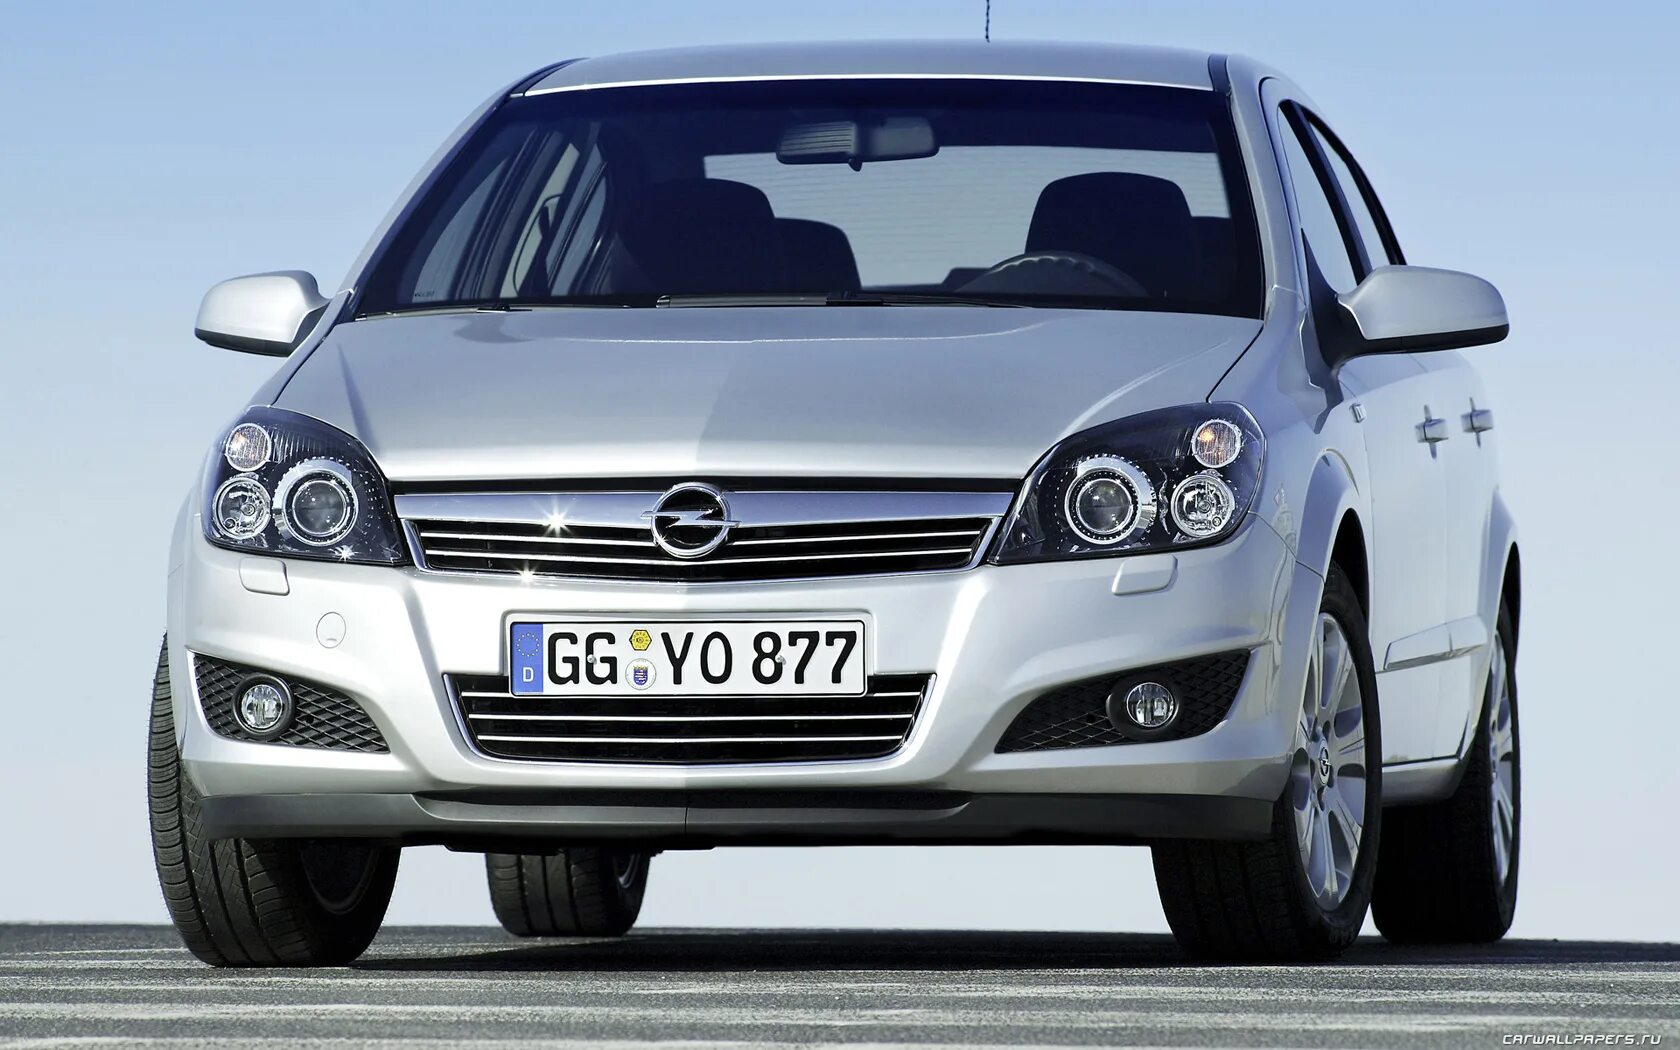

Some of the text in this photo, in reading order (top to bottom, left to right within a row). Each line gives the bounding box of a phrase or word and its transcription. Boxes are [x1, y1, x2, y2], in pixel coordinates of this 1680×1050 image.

[521, 666, 535, 683] D
[547, 630, 858, 685] GG YO 877
